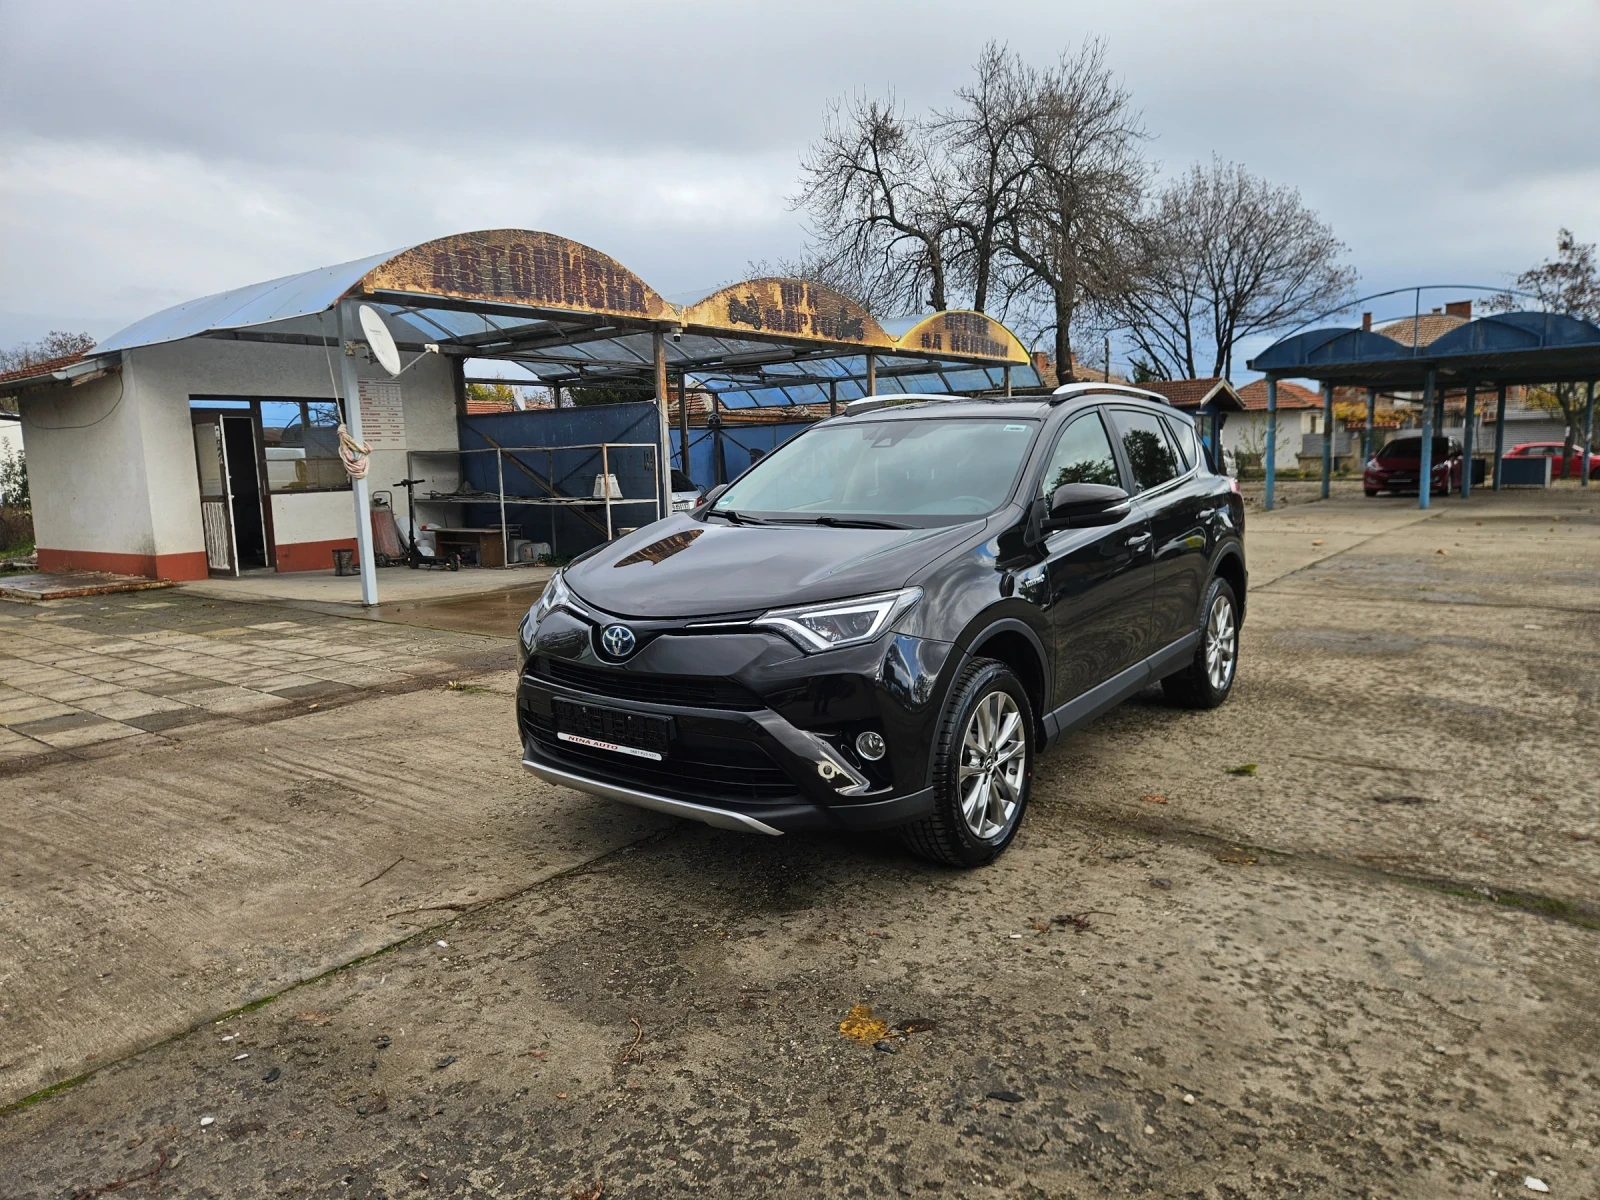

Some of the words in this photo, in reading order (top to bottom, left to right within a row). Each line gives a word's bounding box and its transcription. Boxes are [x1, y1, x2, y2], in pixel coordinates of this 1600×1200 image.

[921, 333, 942, 350] НА
[568, 735, 591, 745] NINA
[593, 741, 618, 750] AUTO
